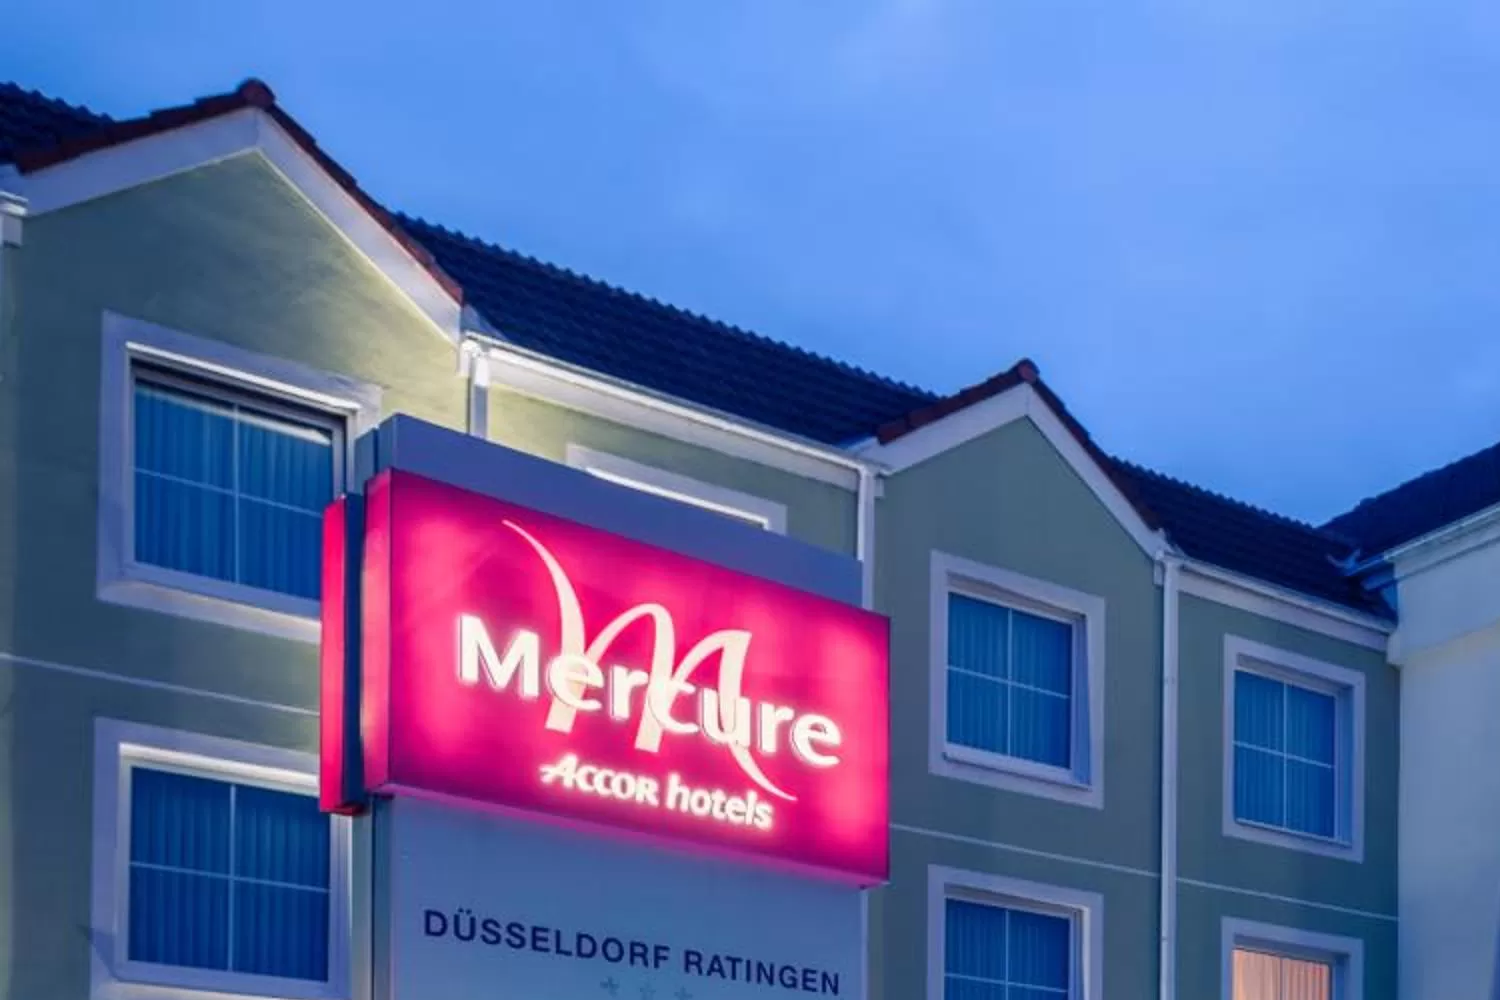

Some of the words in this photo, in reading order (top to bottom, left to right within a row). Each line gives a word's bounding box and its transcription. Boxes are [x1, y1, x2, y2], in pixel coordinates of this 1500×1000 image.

[456, 613, 842, 766] Mercure
[666, 772, 774, 829] hotels
[423, 908, 670, 969] DÜSSELDORF
[684, 949, 840, 996] RATINGEN
